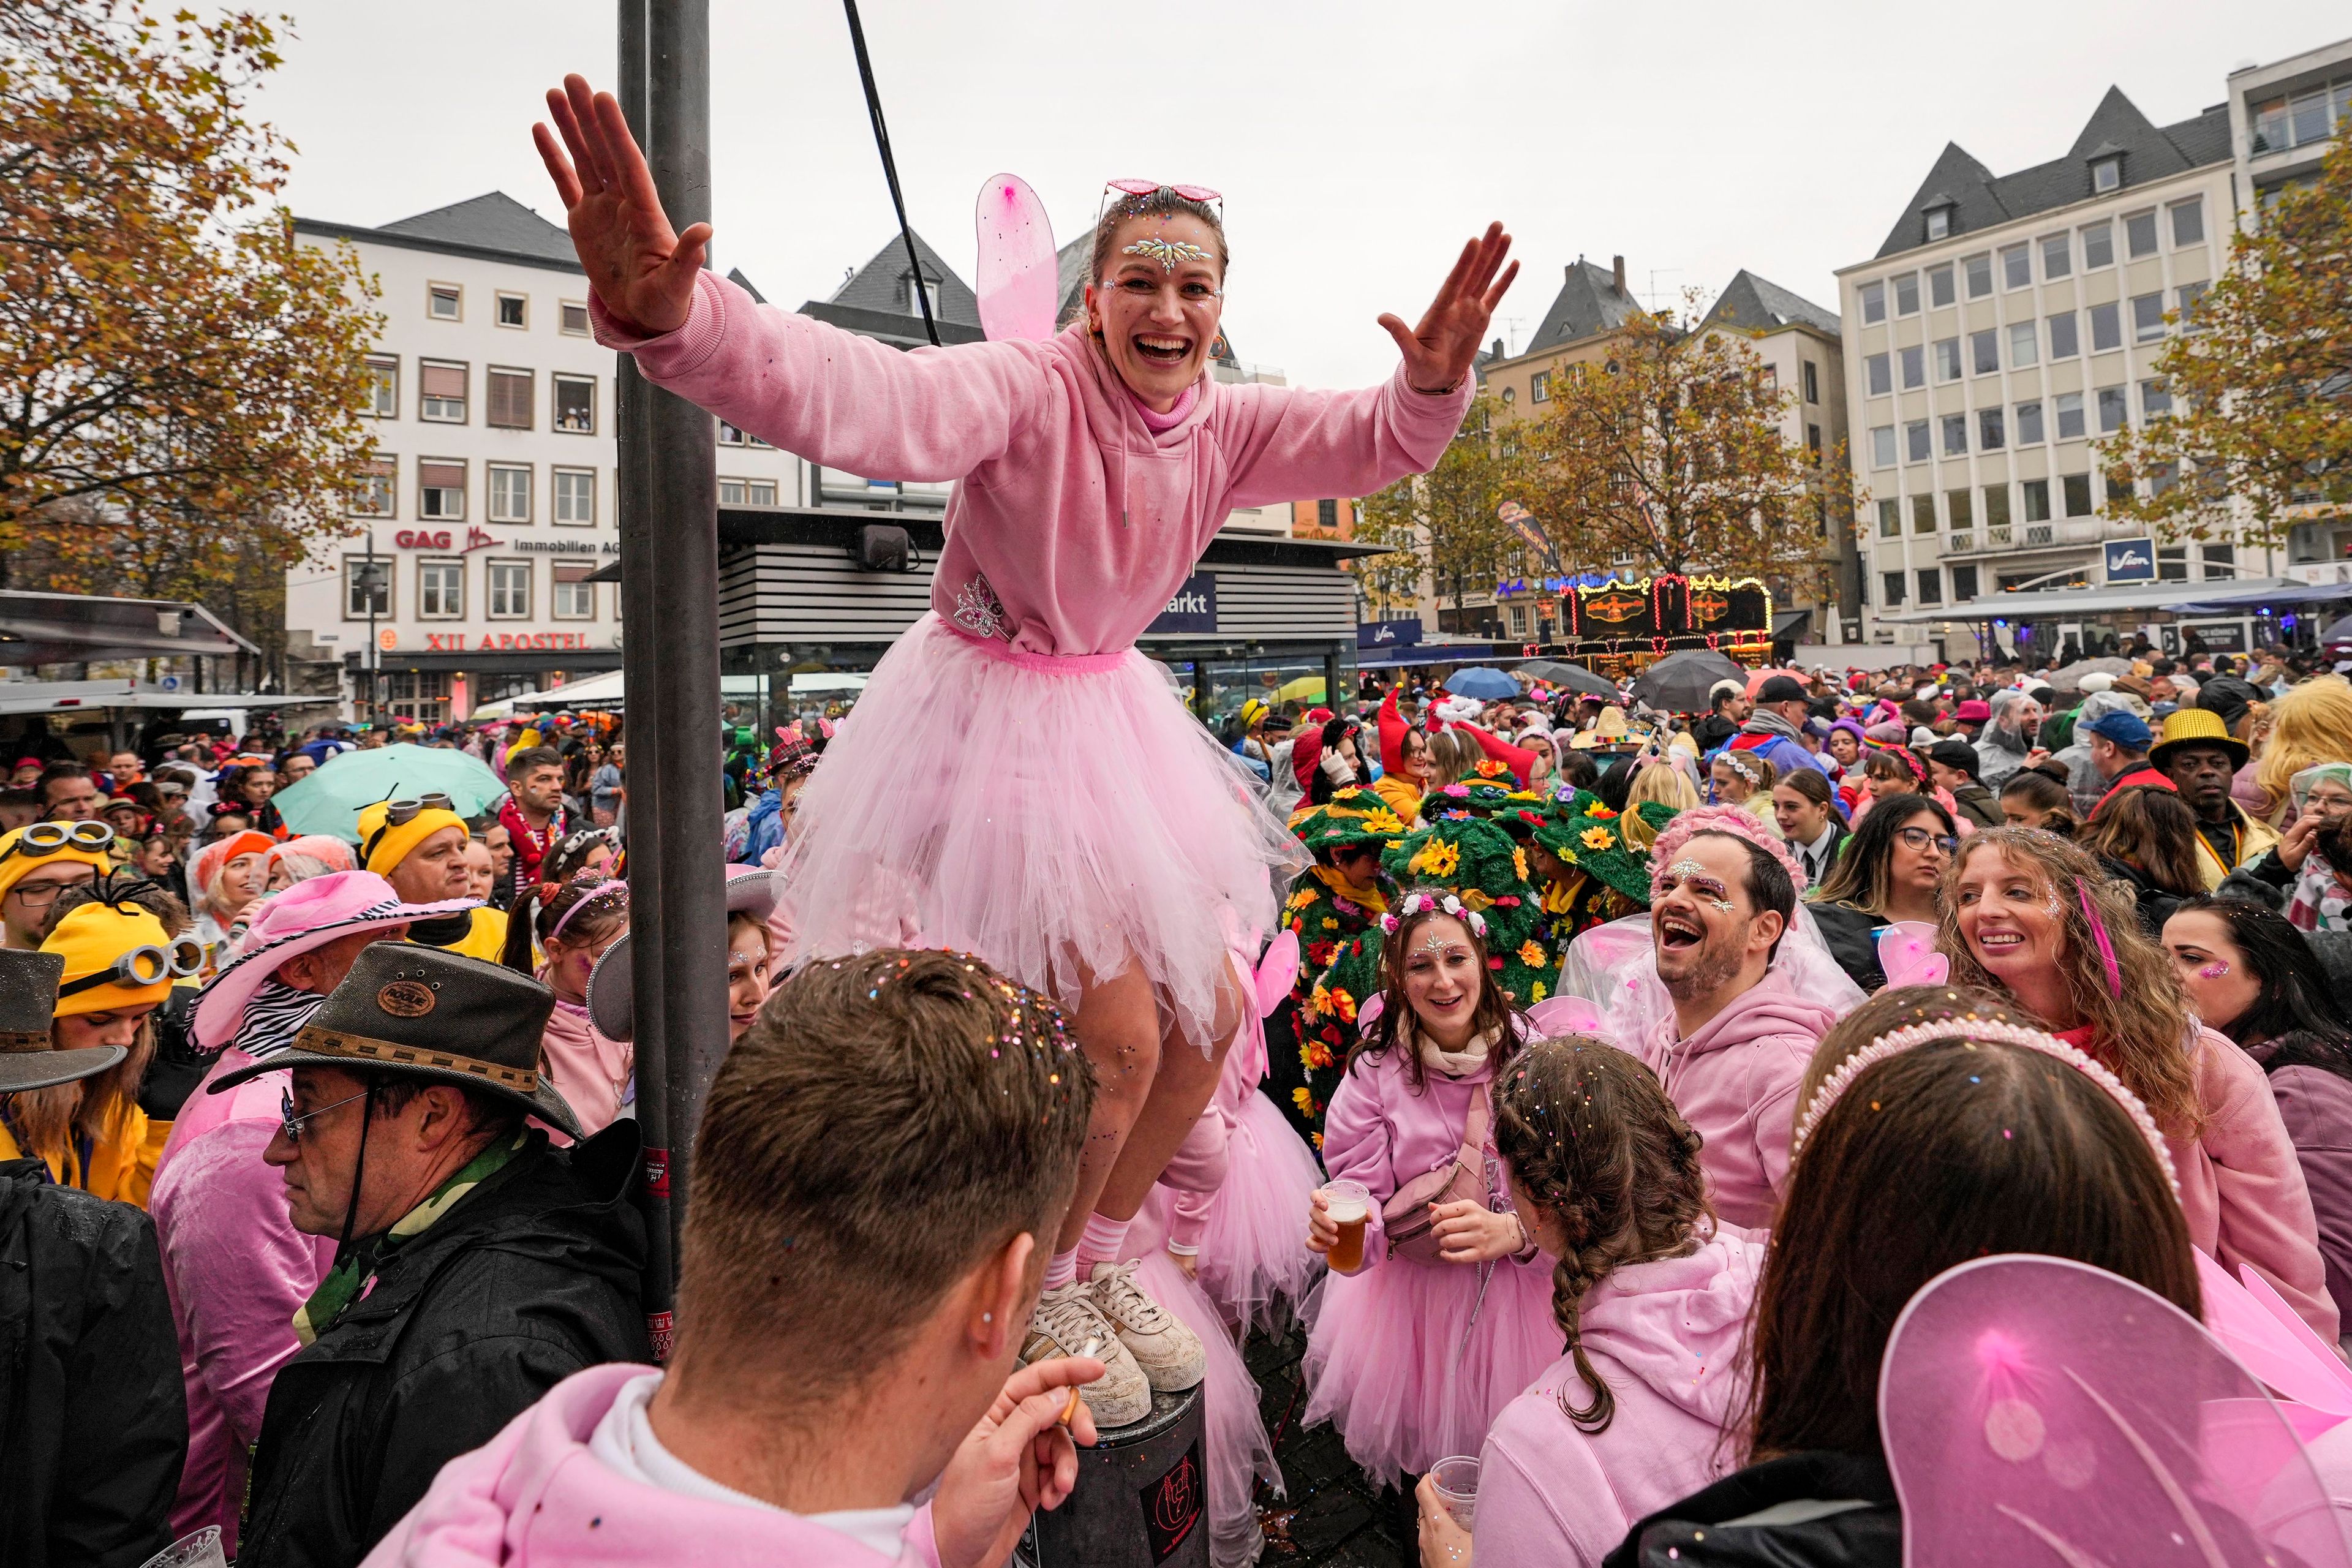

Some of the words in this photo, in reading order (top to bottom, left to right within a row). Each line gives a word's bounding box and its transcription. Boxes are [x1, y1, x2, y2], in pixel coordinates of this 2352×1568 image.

[395, 530, 451, 549] GAG
[514, 539, 597, 553] Immobilien
[602, 541, 620, 554] AG
[2108, 549, 2150, 571] Sion
[1163, 590, 1207, 614] arkt
[427, 633, 466, 651] XII
[479, 633, 592, 650] APOSTEL
[1374, 625, 1395, 643] Sion
[385, 987, 428, 1006] ROGUE
